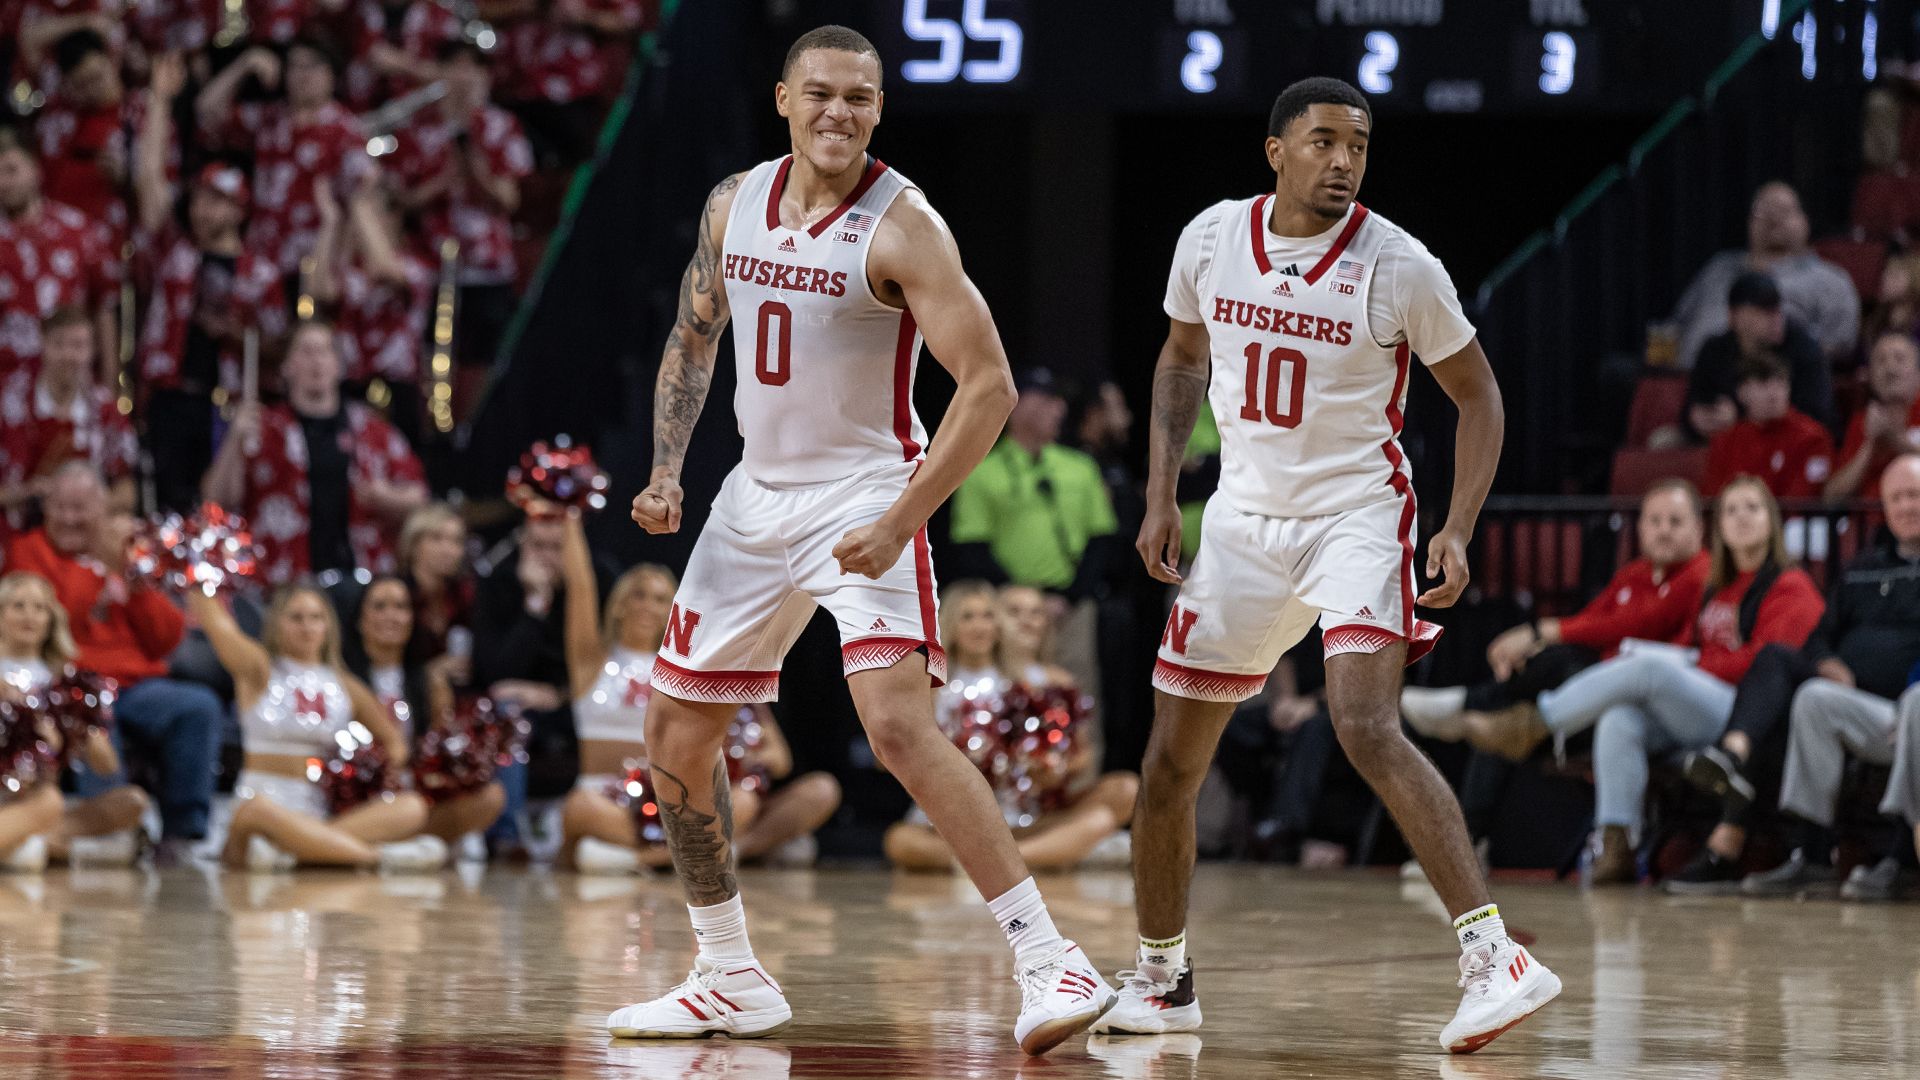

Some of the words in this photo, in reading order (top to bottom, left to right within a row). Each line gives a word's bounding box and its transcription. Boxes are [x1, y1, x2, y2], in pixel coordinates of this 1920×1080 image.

[901, 0, 1024, 83] 55
[1181, 30, 1223, 93] 2
[1358, 31, 1399, 94] 2
[1538, 32, 1577, 94] 3
[725, 254, 848, 297] HUSKERS
[778, 245, 797, 253] adidas
[1212, 297, 1353, 346] HUSKERS
[1272, 289, 1294, 298] adidas
[755, 300, 792, 387] 0
[1239, 341, 1308, 430] 10
[663, 601, 702, 659] N
[1162, 602, 1200, 658] N
